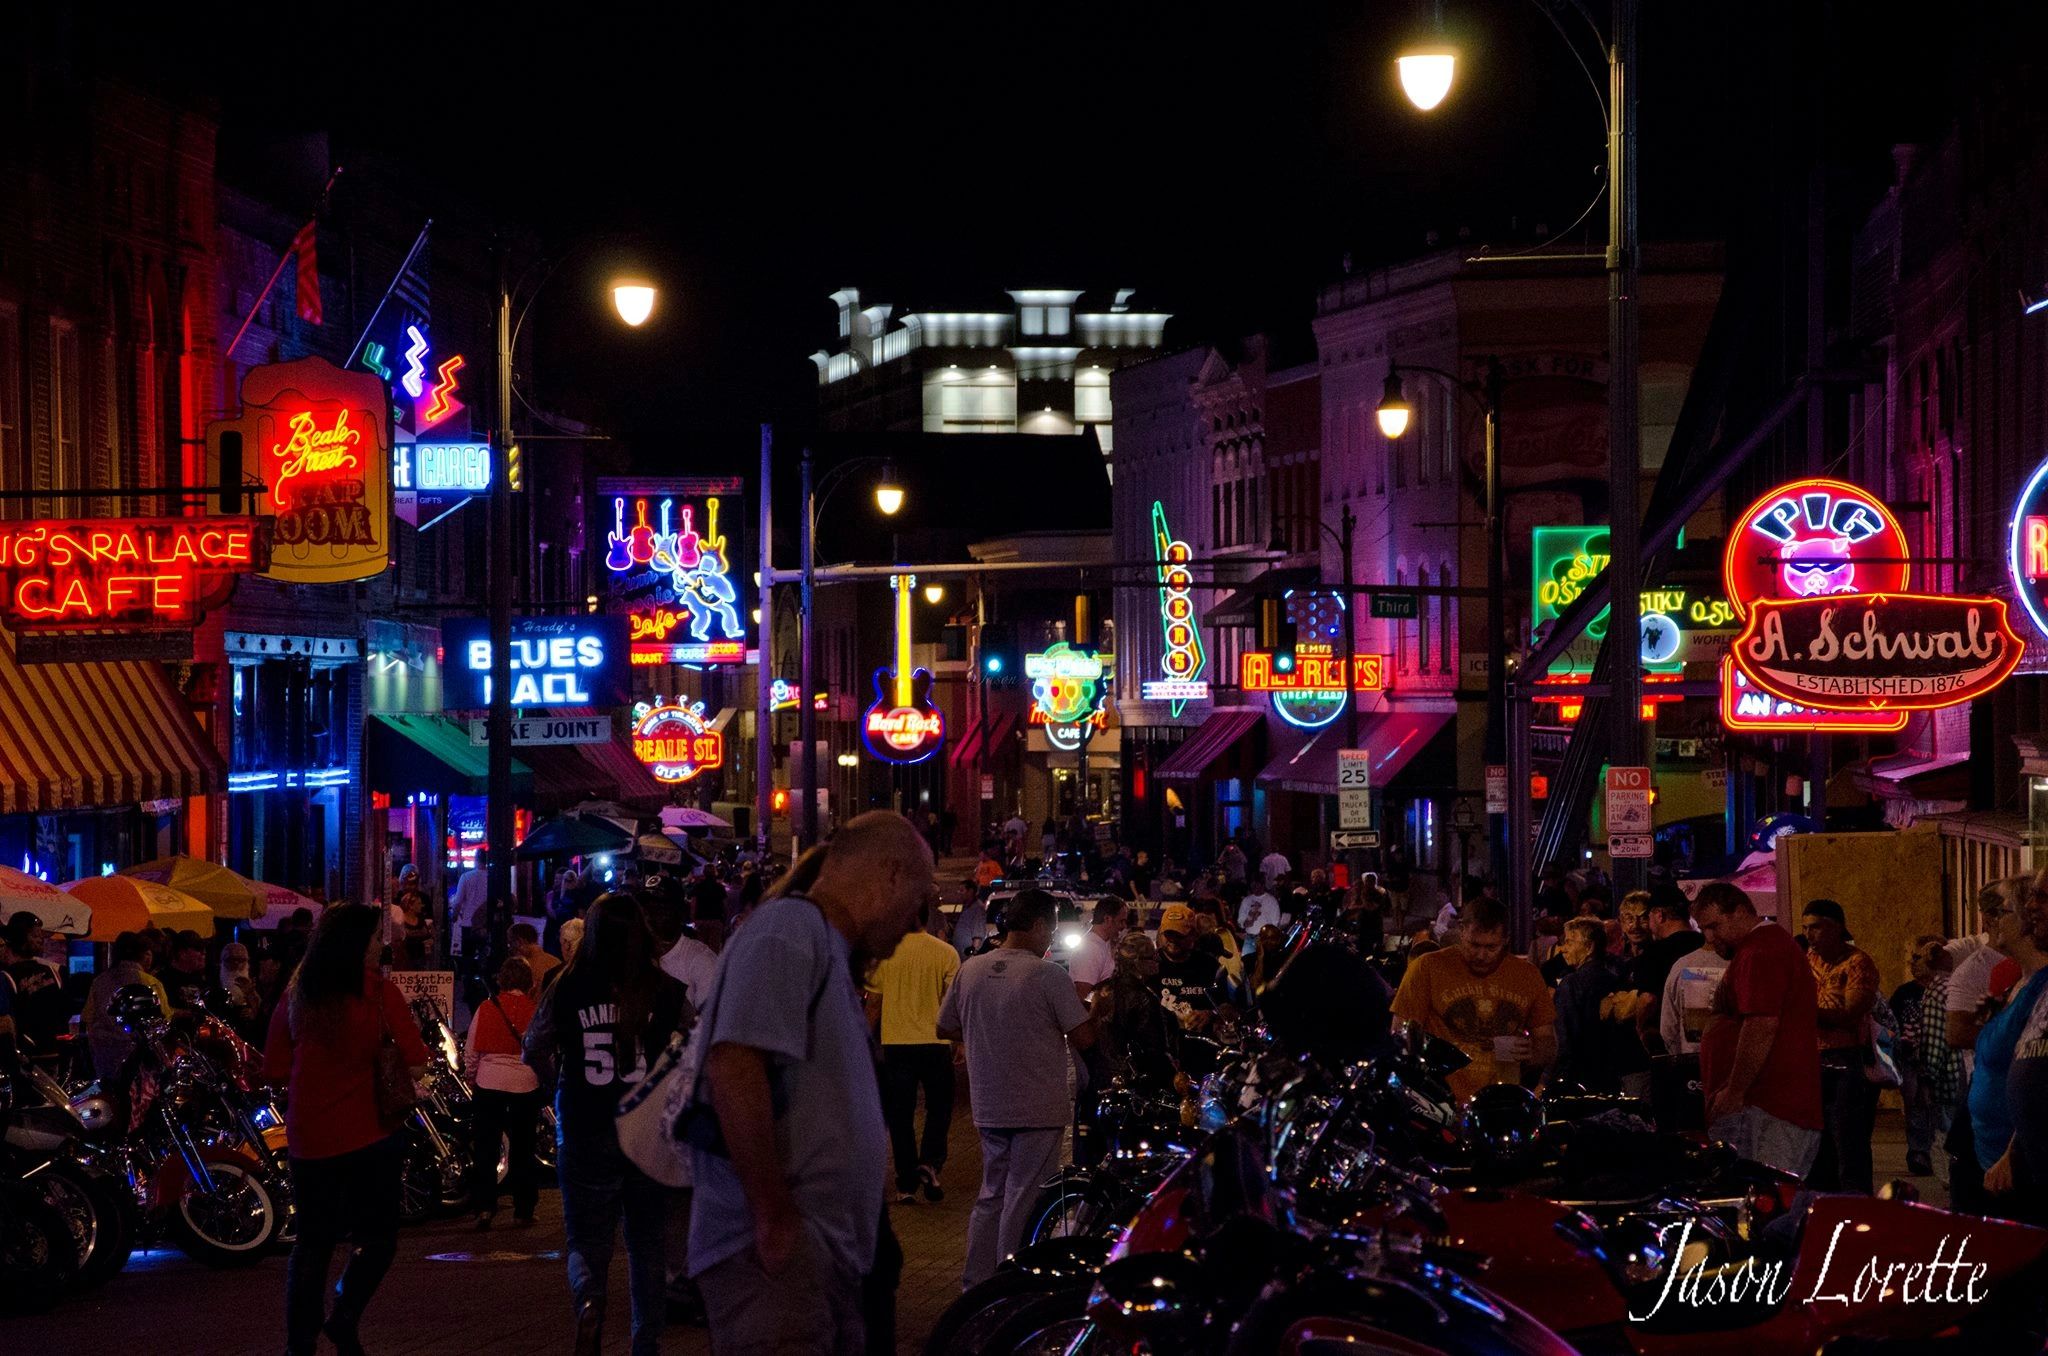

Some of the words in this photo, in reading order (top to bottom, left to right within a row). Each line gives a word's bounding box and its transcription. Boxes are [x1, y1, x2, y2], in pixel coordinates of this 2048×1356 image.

[273, 409, 360, 457] Beale
[420, 447, 490, 487] CARGO
[272, 505, 377, 545] OOM
[1751, 493, 1884, 541] PIG
[19, 576, 183, 615] CAFE
[1377, 600, 1410, 614] Third
[523, 621, 576, 634] Handy's
[1809, 607, 2006, 662] Schwab
[483, 673, 588, 705] ALL
[1796, 675, 1923, 696] ESTABLISHED
[1930, 676, 1965, 695] 1876
[481, 722, 529, 741] JKE
[542, 721, 599, 739] JOINT
[634, 739, 689, 762] BEALE
[1341, 770, 1365, 784] 25
[1616, 772, 1641, 786] NO
[1610, 792, 1645, 800] PARKING
[391, 973, 452, 985] absinthe
[404, 985, 438, 993] room
